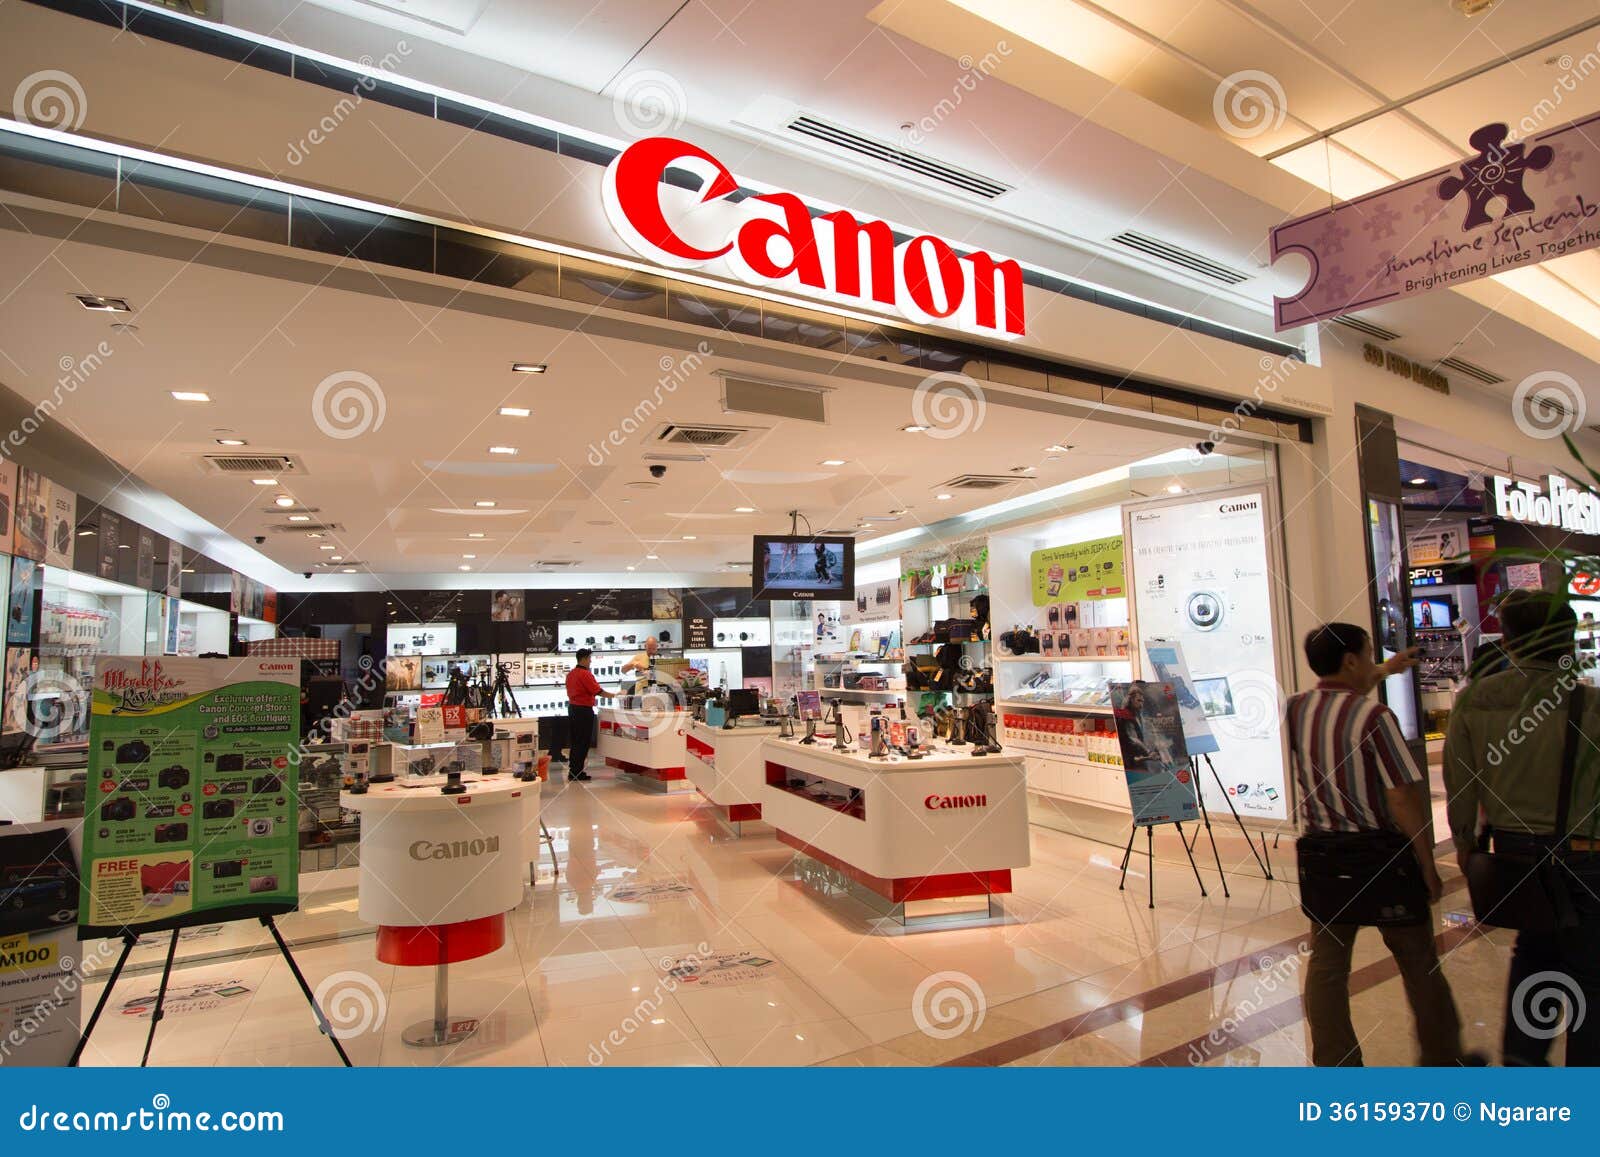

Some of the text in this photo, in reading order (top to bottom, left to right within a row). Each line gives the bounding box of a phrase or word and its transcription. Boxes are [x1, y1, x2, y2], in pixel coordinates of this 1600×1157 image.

[614, 137, 1026, 336] Canon
[1386, 237, 1482, 277] Sunshine
[1405, 262, 1487, 291] Brightening
[1492, 250, 1531, 268] Lives
[1219, 501, 1257, 513] Canon
[1409, 569, 1443, 579] oPro
[258, 662, 294, 671] Canon
[214, 694, 254, 703] Exclusive
[199, 704, 227, 713] Canon
[924, 794, 987, 810] Canon
[409, 835, 499, 861] Canon
[98, 860, 139, 873] FREE
[1, 940, 21, 949] car
